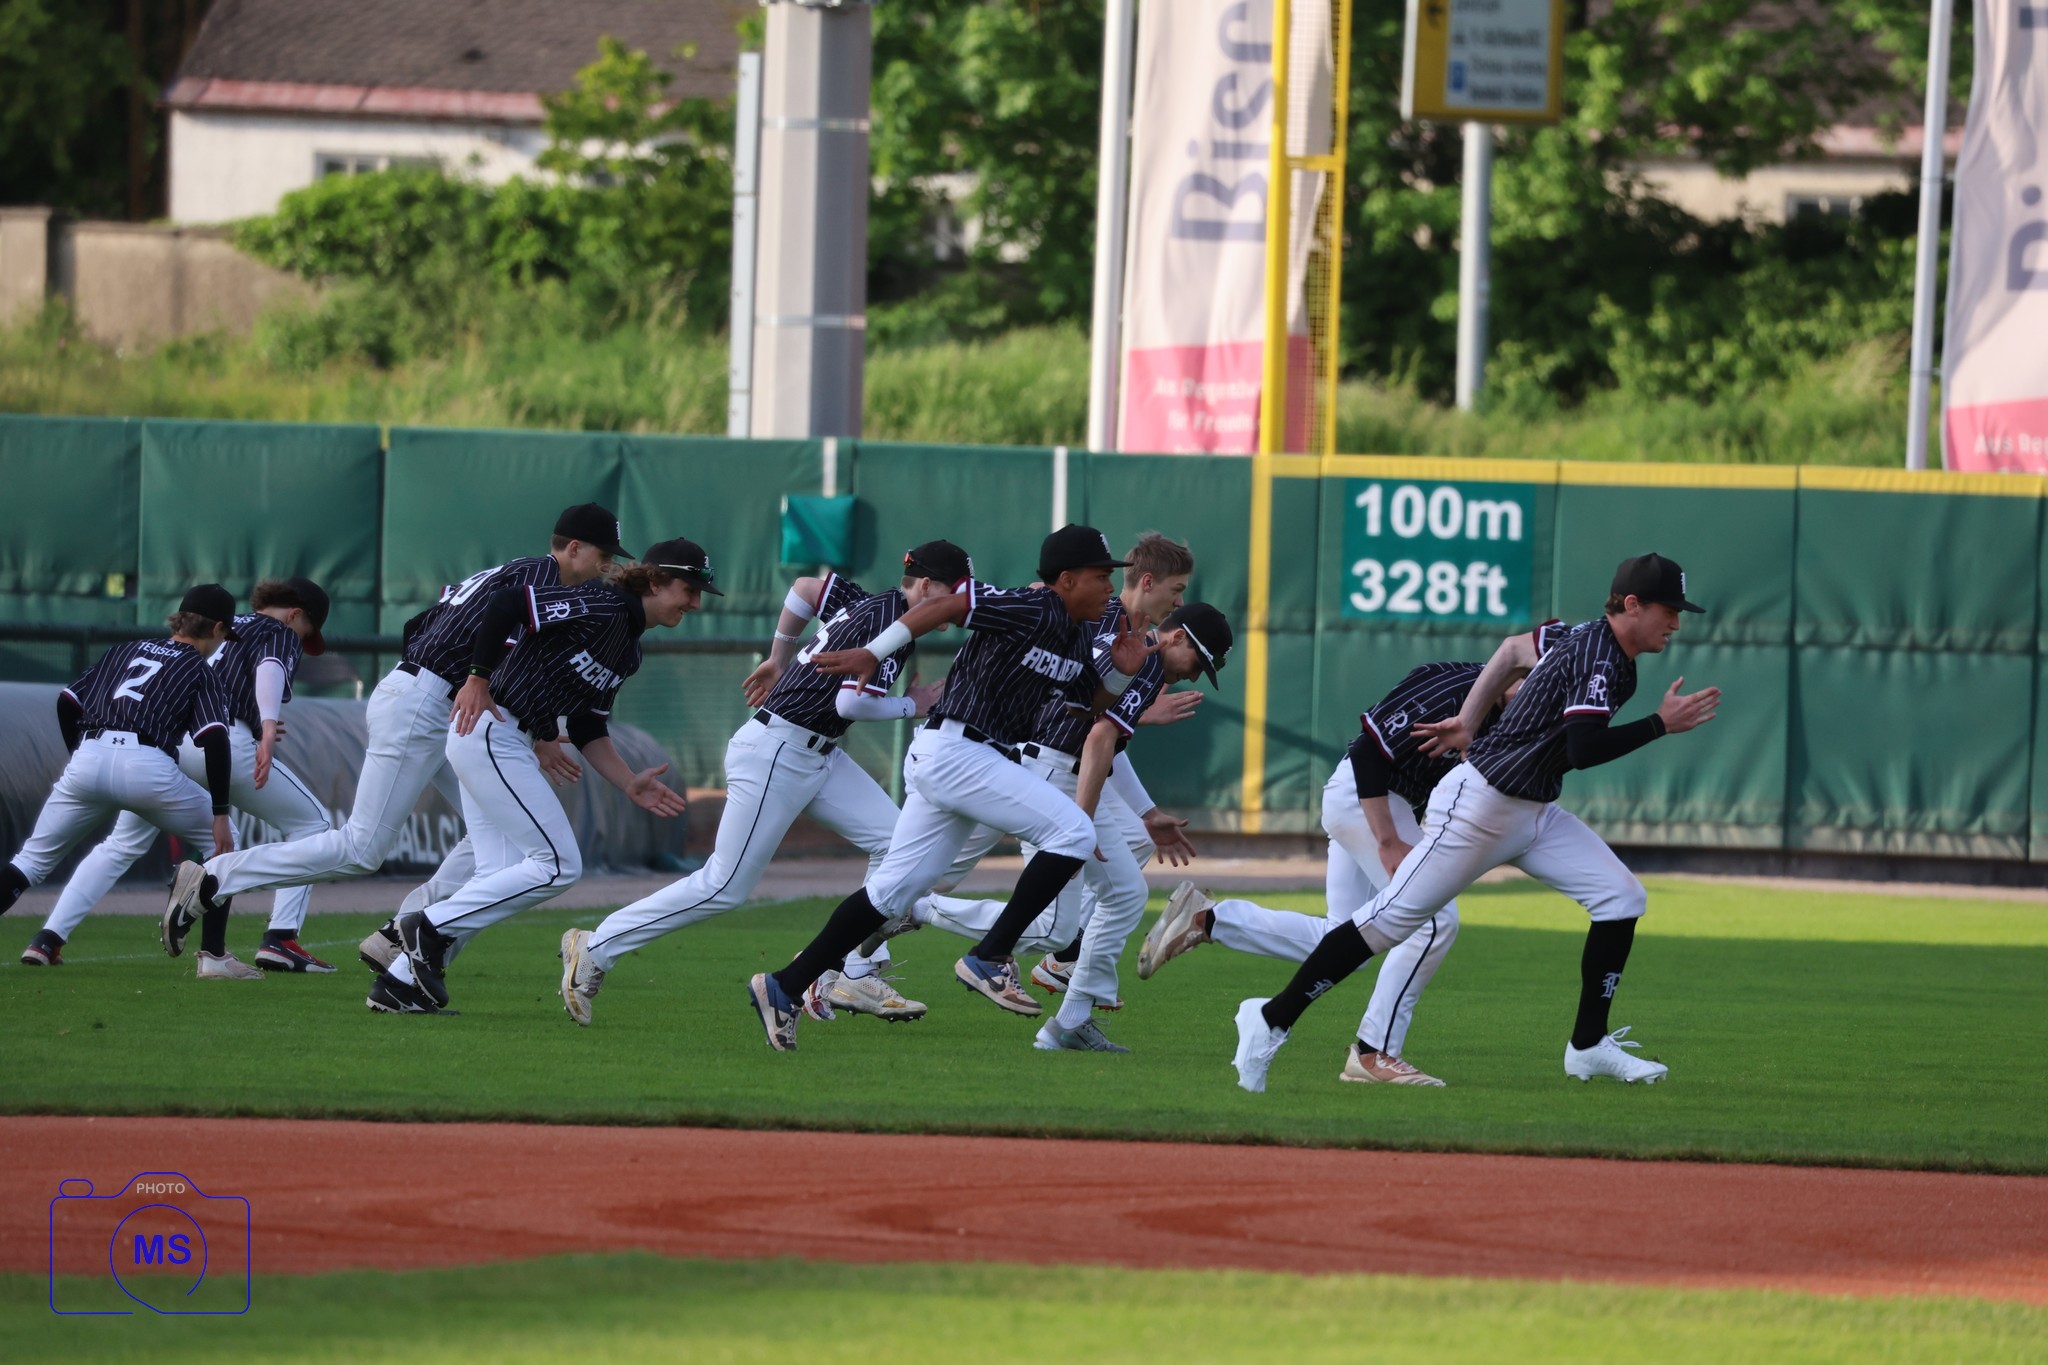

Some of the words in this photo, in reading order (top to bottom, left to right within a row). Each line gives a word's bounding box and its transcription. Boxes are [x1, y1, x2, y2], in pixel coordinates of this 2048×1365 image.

[1355, 483, 1523, 541] 100m
[1350, 558, 1508, 616] 328ft
[138, 641, 182, 658] TEUSCH
[114, 656, 163, 702] 2
